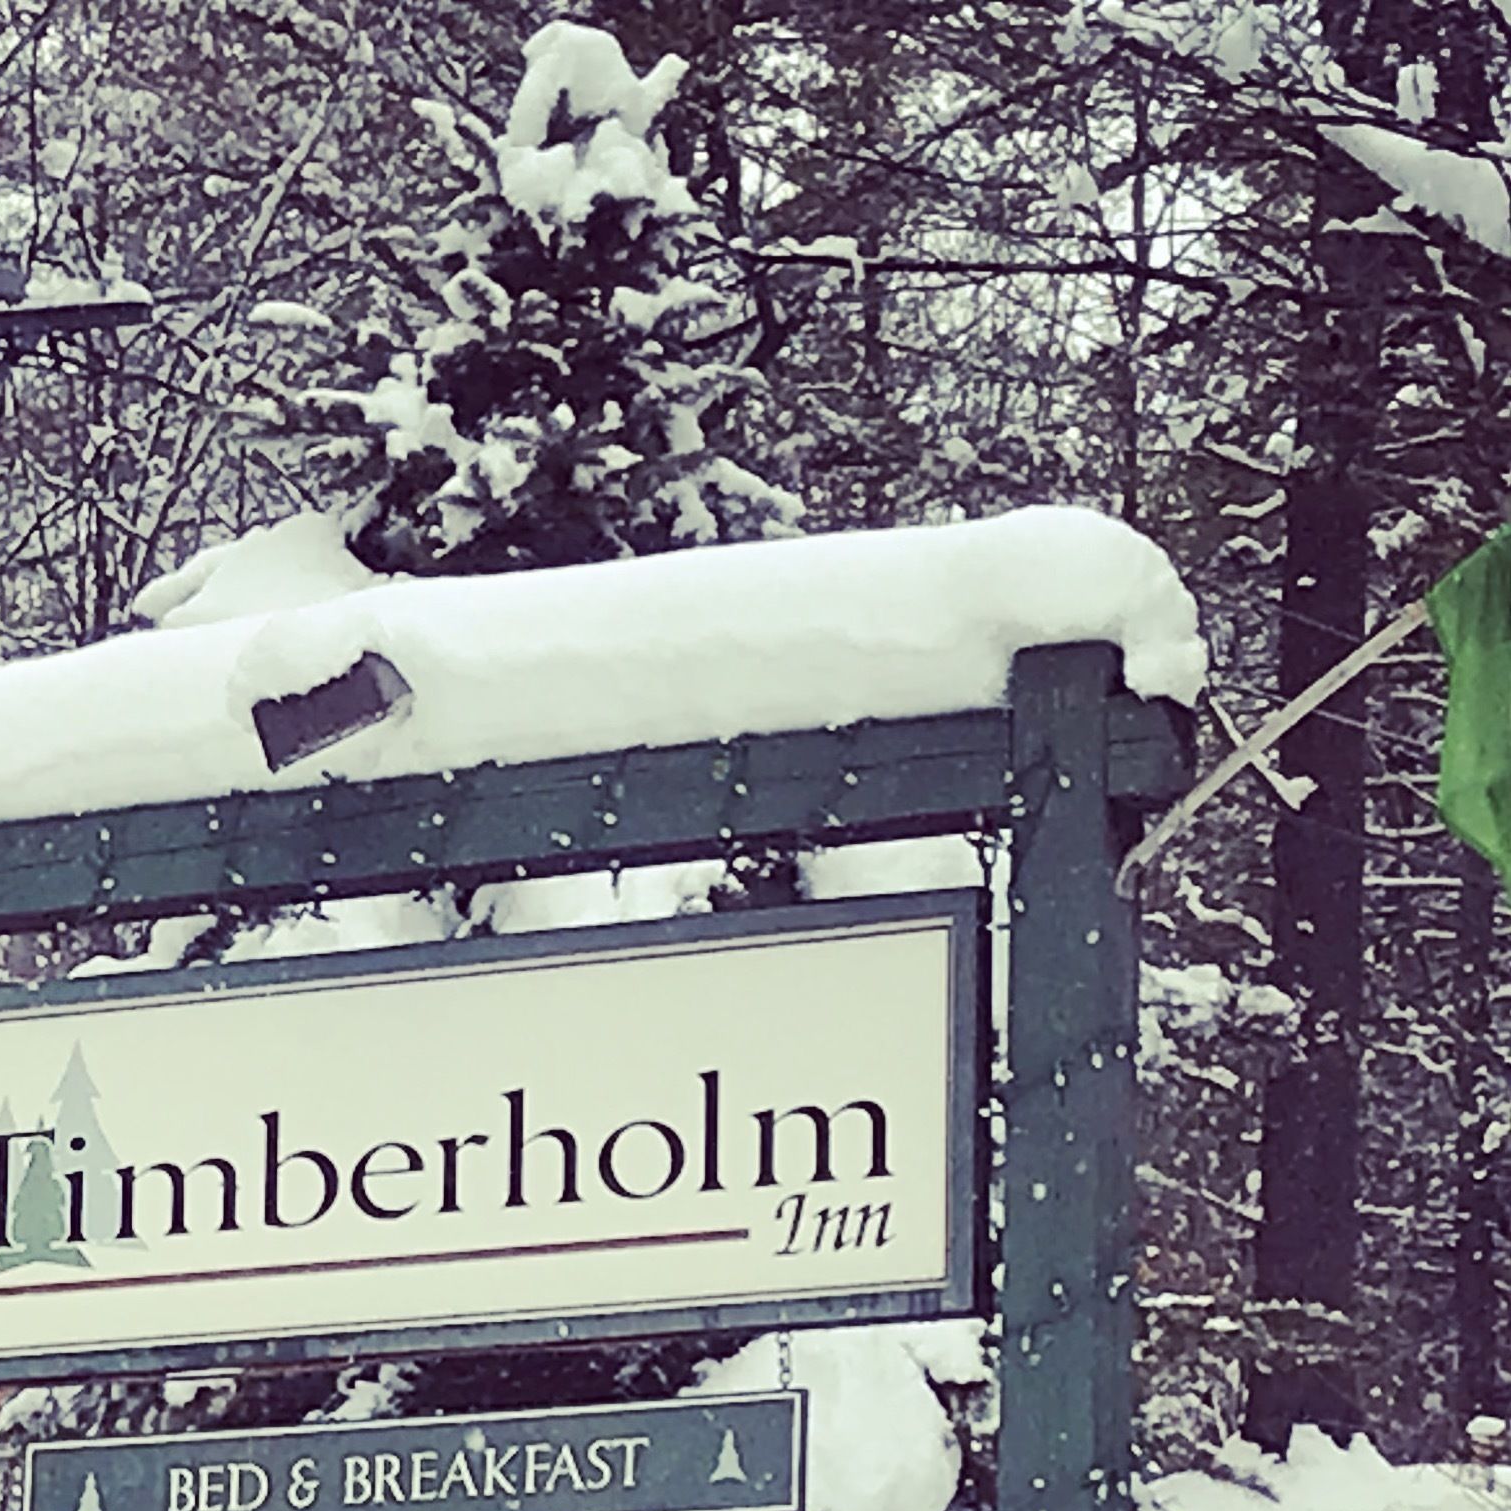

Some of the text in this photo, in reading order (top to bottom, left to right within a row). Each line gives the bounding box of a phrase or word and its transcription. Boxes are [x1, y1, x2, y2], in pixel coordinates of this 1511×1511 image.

[772, 1193, 896, 1256] Inn
[287, 1456, 321, 1510] &
[343, 1436, 651, 1506] BREAKFAST
